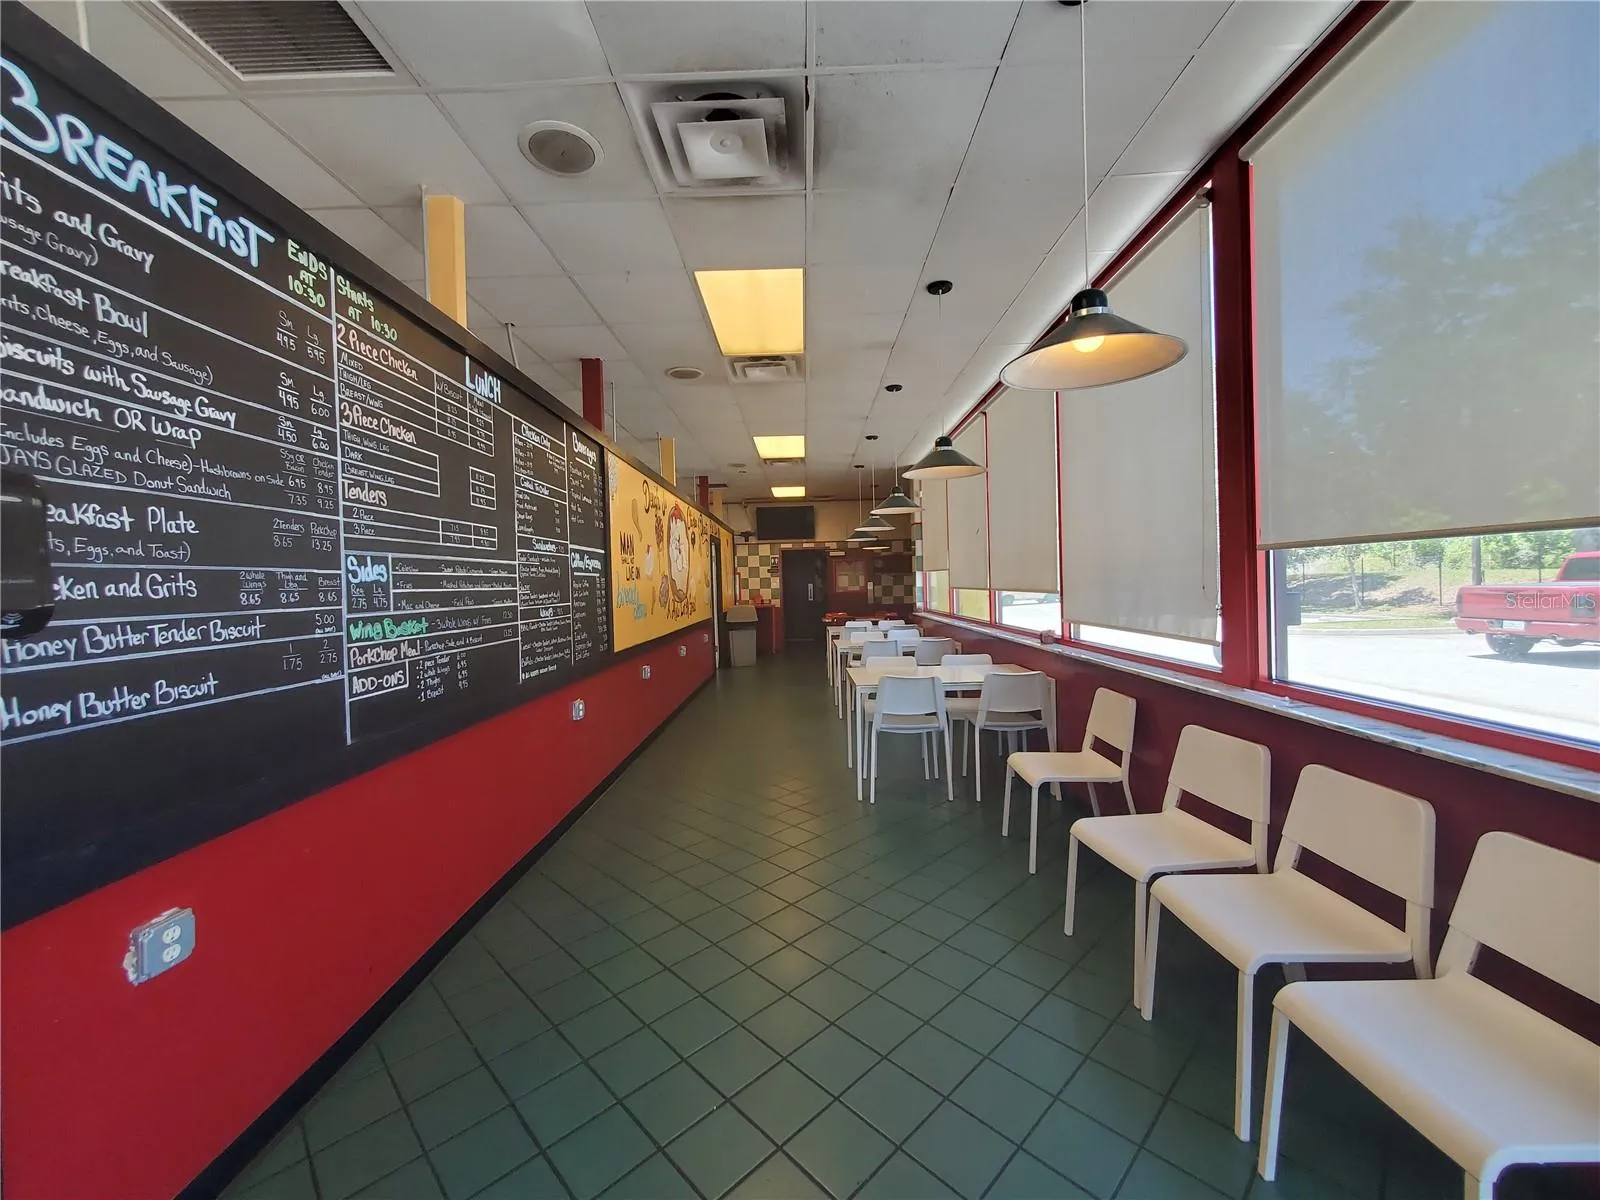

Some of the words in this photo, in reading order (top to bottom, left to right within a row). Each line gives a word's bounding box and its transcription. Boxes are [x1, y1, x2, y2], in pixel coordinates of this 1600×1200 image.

[53, 210, 98, 241] and
[98, 223, 155, 274] Gravy
[288, 274, 326, 308] 10:30
[300, 269, 317, 287] AT
[94, 292, 148, 338] Bowl
[370, 315, 398, 341] 10:30
[135, 345, 159, 362] and
[336, 323, 348, 347] 2
[349, 329, 379, 361] Piece
[379, 349, 419, 382] Chicken
[83, 365, 131, 392] with
[131, 372, 194, 419] Sausage
[194, 396, 237, 429] Gravy
[0, 384, 102, 422] andwich
[114, 407, 147, 431] OR
[151, 416, 202, 449] Wrap
[341, 401, 353, 426] 3
[352, 404, 380, 430] Piece
[380, 417, 417, 445] Chicken
[70, 436, 110, 466] Eggs
[114, 447, 143, 465] and
[254, 474, 266, 483] on
[56, 455, 127, 485] GLAZED
[134, 471, 174, 490] Donut
[176, 475, 232, 501] Sandwich
[342, 479, 388, 507] Tenders
[148, 506, 200, 534] Plate
[352, 507, 359, 518] 2
[359, 509, 375, 521] Piece
[353, 523, 360, 535] 3
[360, 524, 376, 536] Piece
[116, 540, 145, 557] and
[347, 555, 388, 584] Sides
[105, 572, 144, 599] and
[146, 572, 199, 600] Grits
[1, 635, 77, 664] Honey
[82, 624, 150, 655] Butter
[147, 619, 207, 648] Tender
[210, 616, 267, 642] Biscuit
[323, 639, 329, 649] 2
[400, 639, 421, 659] Meal
[352, 669, 406, 695] ADD-ONS
[0, 695, 72, 731] Honey
[79, 686, 151, 720] Butter
[154, 672, 219, 706] Biscuit
